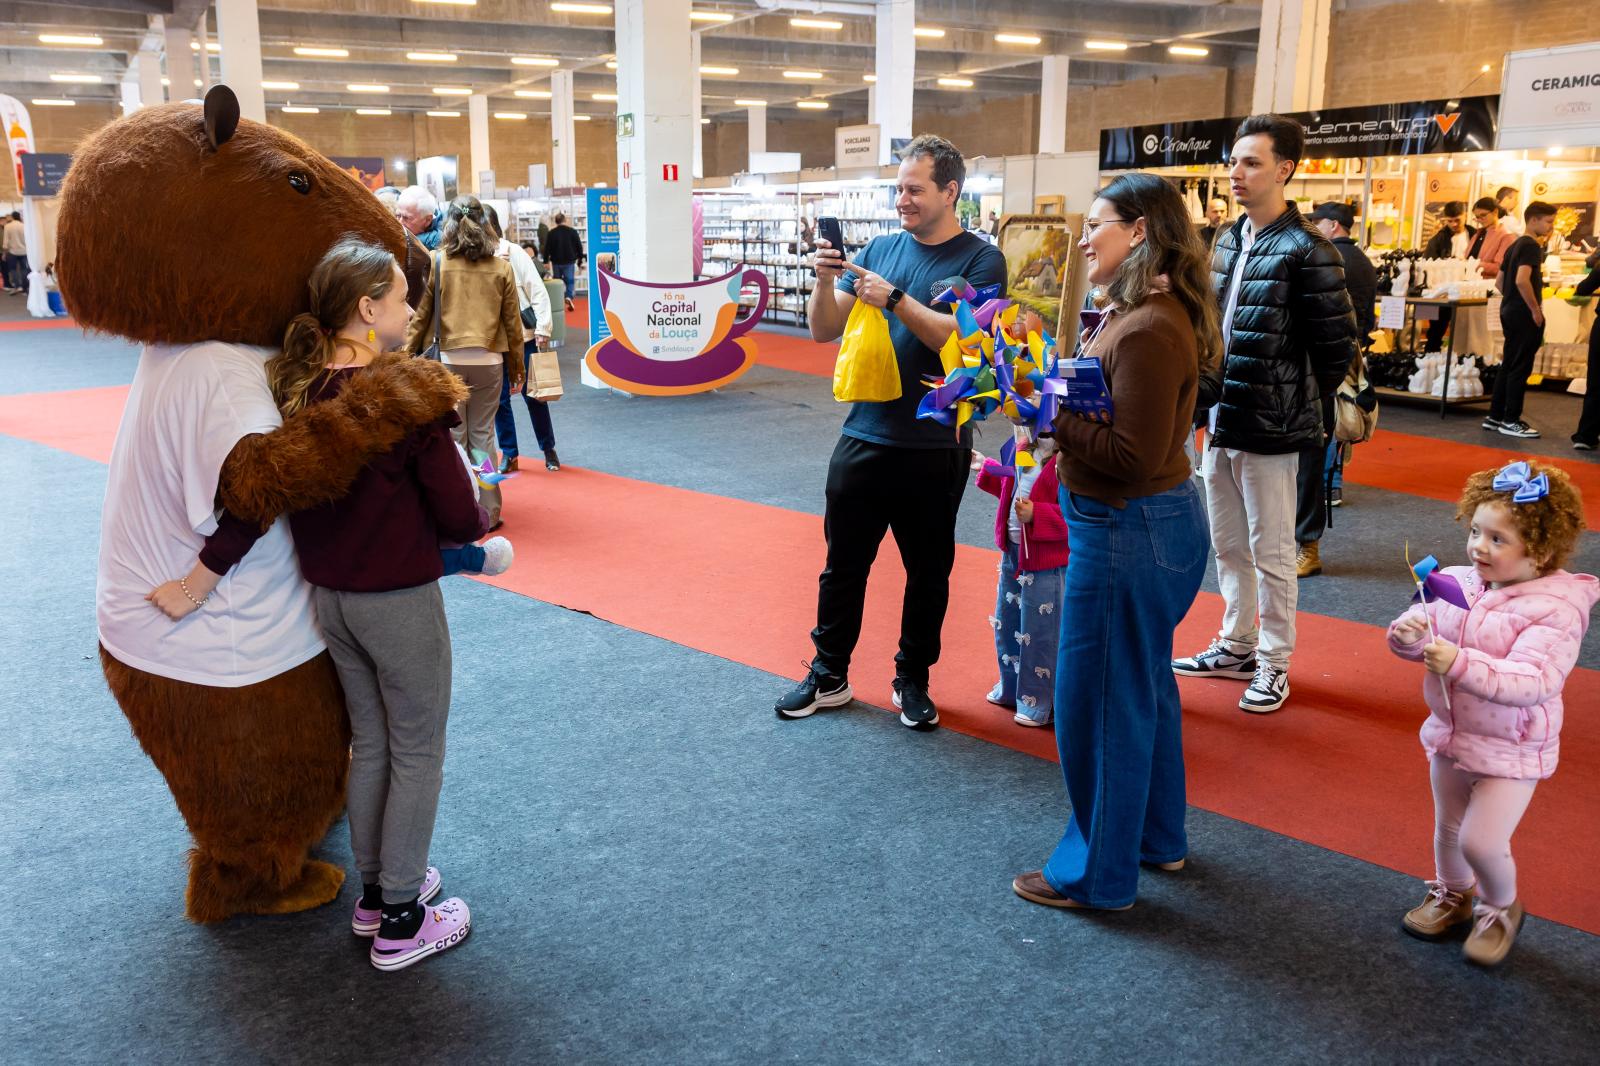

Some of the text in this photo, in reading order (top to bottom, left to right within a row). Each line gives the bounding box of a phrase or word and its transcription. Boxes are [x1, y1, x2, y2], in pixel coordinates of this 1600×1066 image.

[1323, 134, 1348, 143] vazados
[1349, 134, 1358, 142] de
[1359, 132, 1390, 141] cerâmica
[600, 205, 607, 213] O
[652, 300, 696, 316] Capital
[647, 313, 701, 326] Nacional
[649, 327, 698, 341] da Louça
[435, 921, 470, 950] crocs
